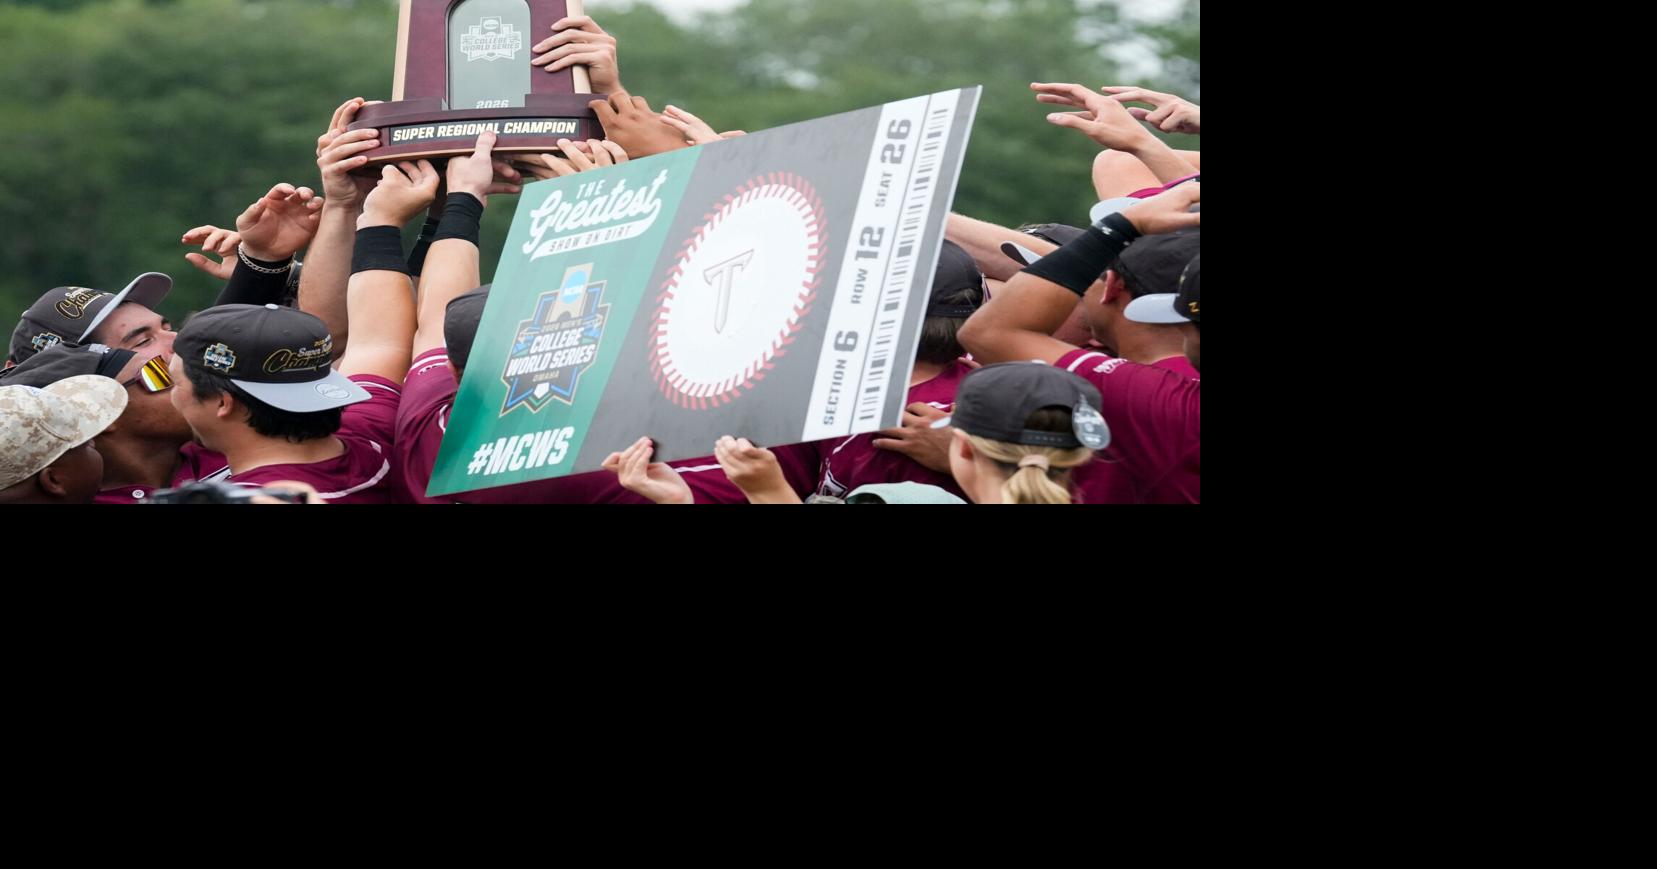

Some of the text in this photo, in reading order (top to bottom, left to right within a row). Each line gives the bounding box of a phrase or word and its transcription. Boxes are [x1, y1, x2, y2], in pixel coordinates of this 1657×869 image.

[476, 99, 509, 109] 2026
[393, 121, 577, 142] SUPER REGIONAL CHAMPION
[576, 179, 606, 199] THE
[522, 169, 668, 254] Greatest
[549, 225, 633, 252] SHOW ON DIRT
[823, 118, 912, 426] SECTION 6 ROW 12 SEAT 26
[530, 327, 585, 354] COLLEGE
[505, 343, 597, 377] WORLD SERIES
[532, 370, 560, 382] OMAHA
[467, 426, 575, 476] #MCWS
